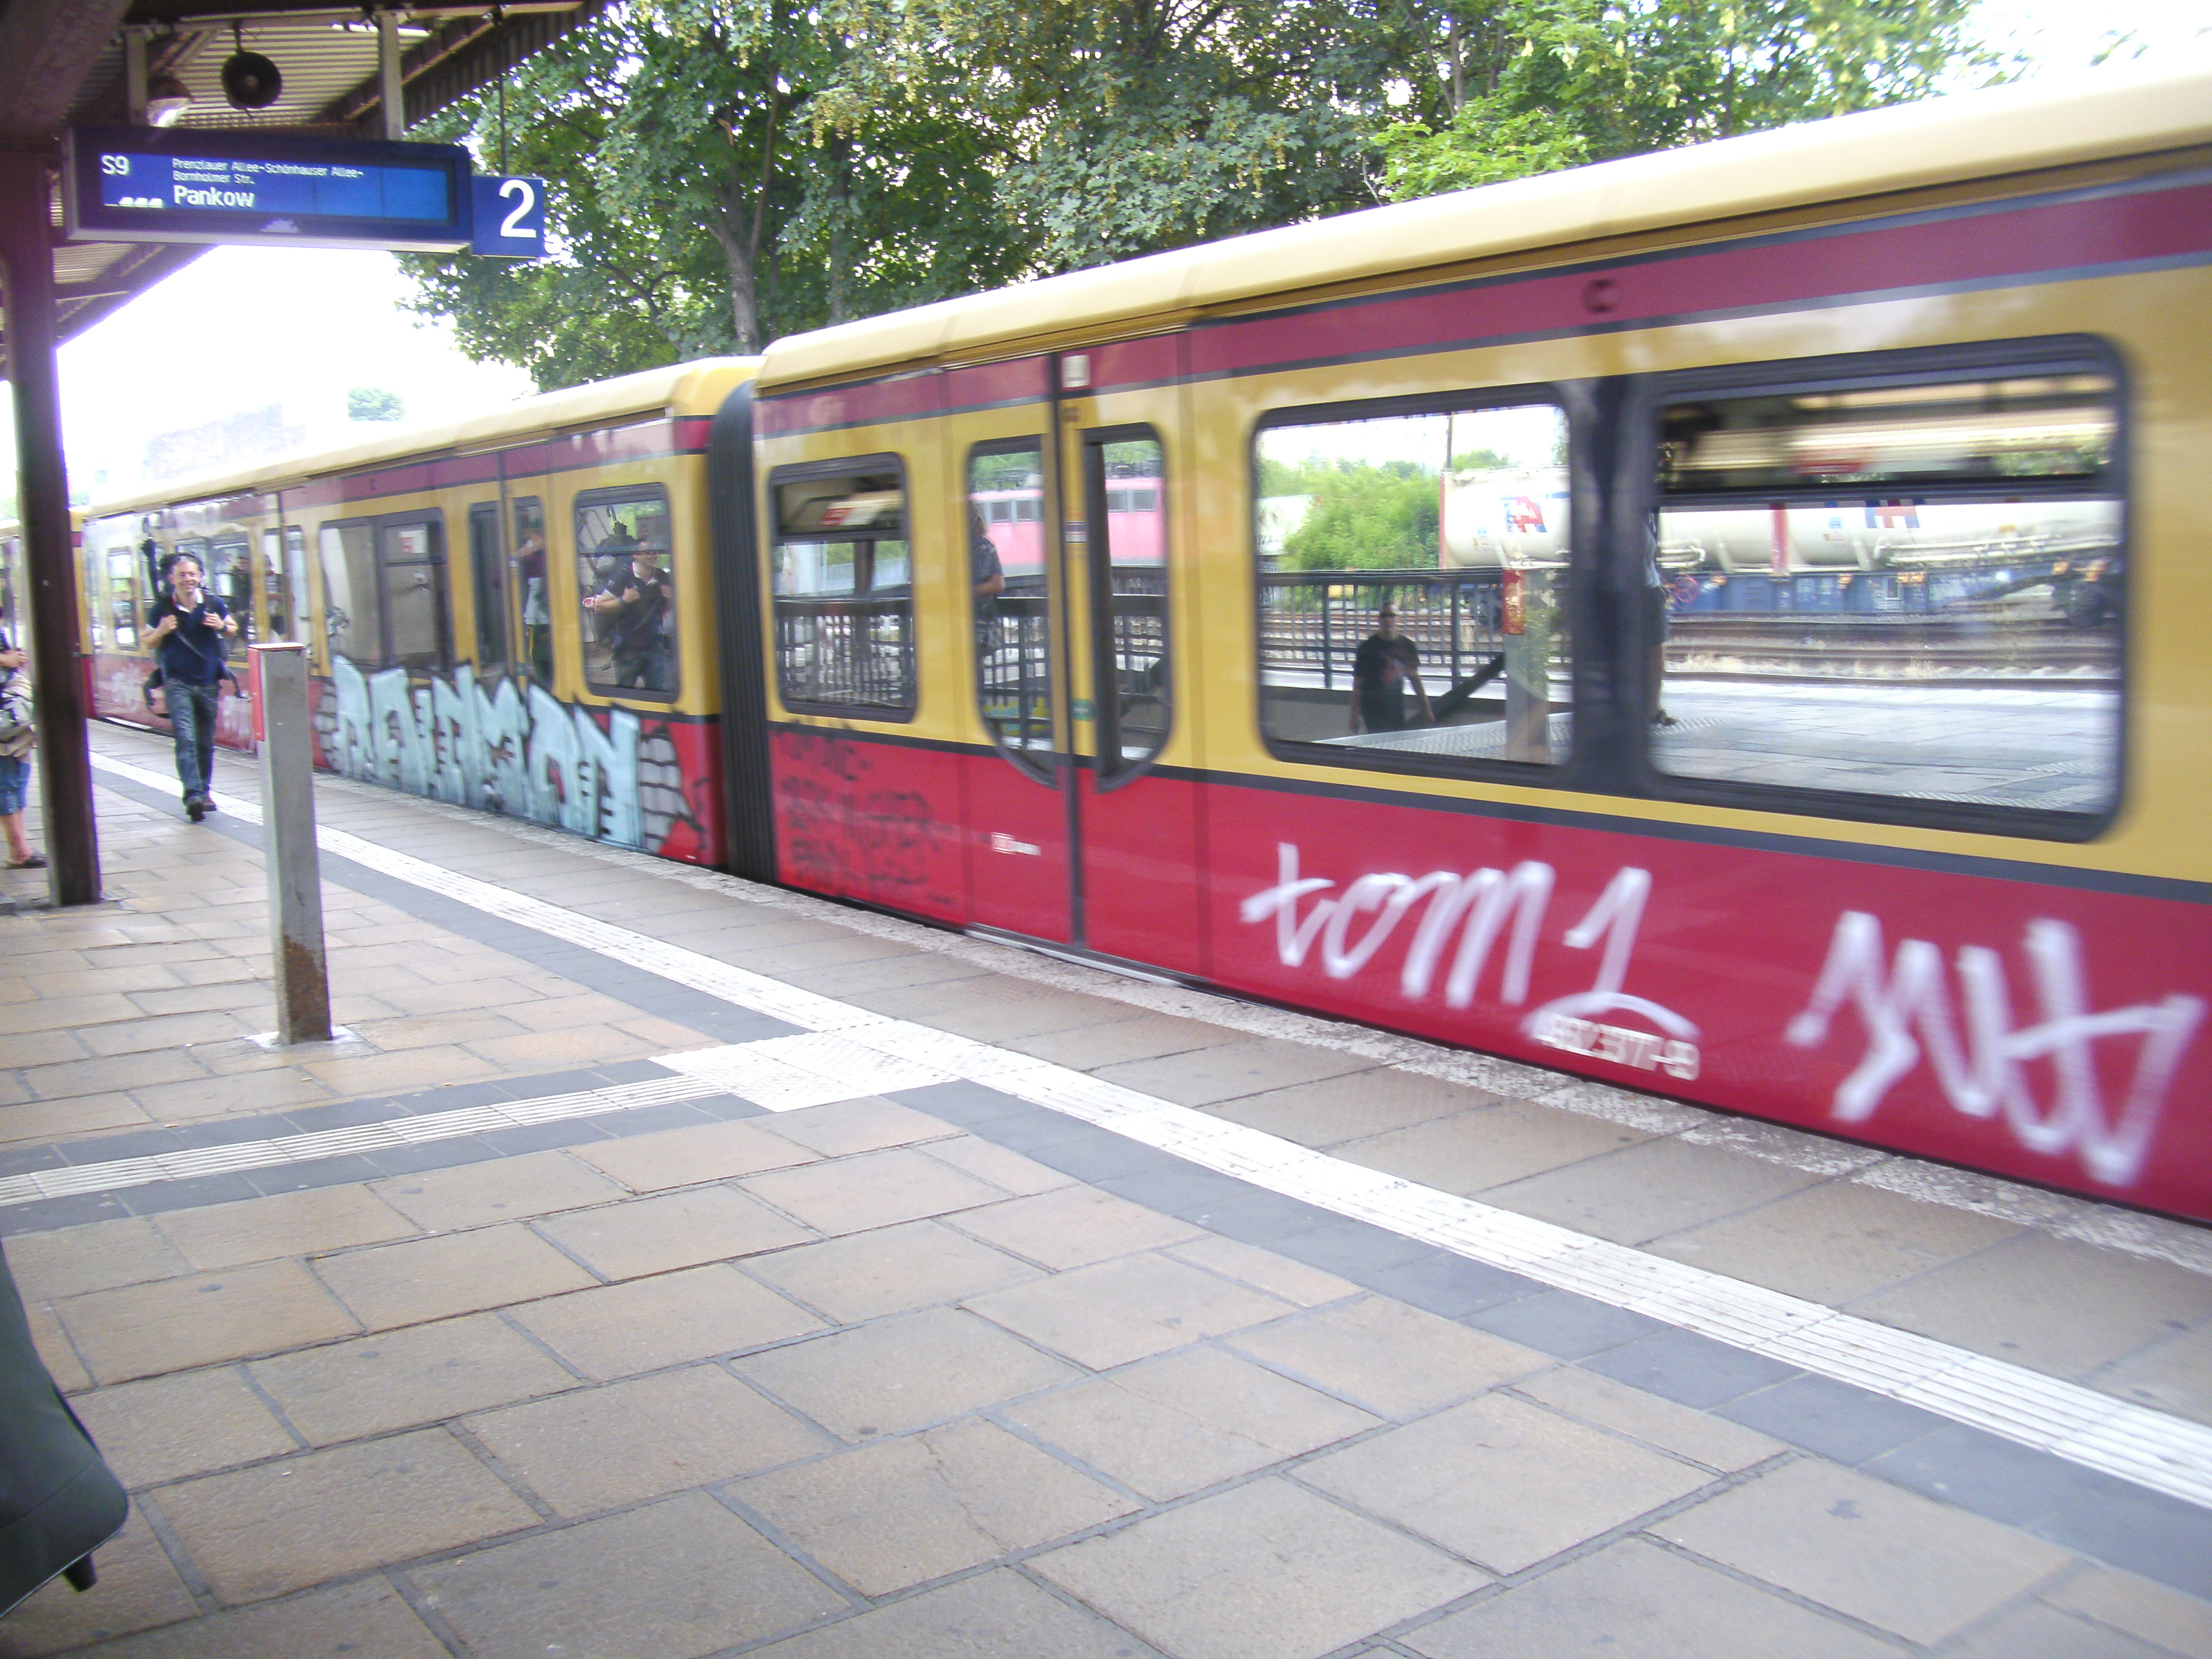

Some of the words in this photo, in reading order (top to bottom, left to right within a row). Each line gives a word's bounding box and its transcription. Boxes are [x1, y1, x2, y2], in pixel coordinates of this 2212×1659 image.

[101, 155, 130, 176] S9
[172, 158, 229, 171] Prenzlauer
[233, 173, 256, 184] Str.
[173, 185, 255, 207] Pankow
[499, 179, 537, 238] 2
